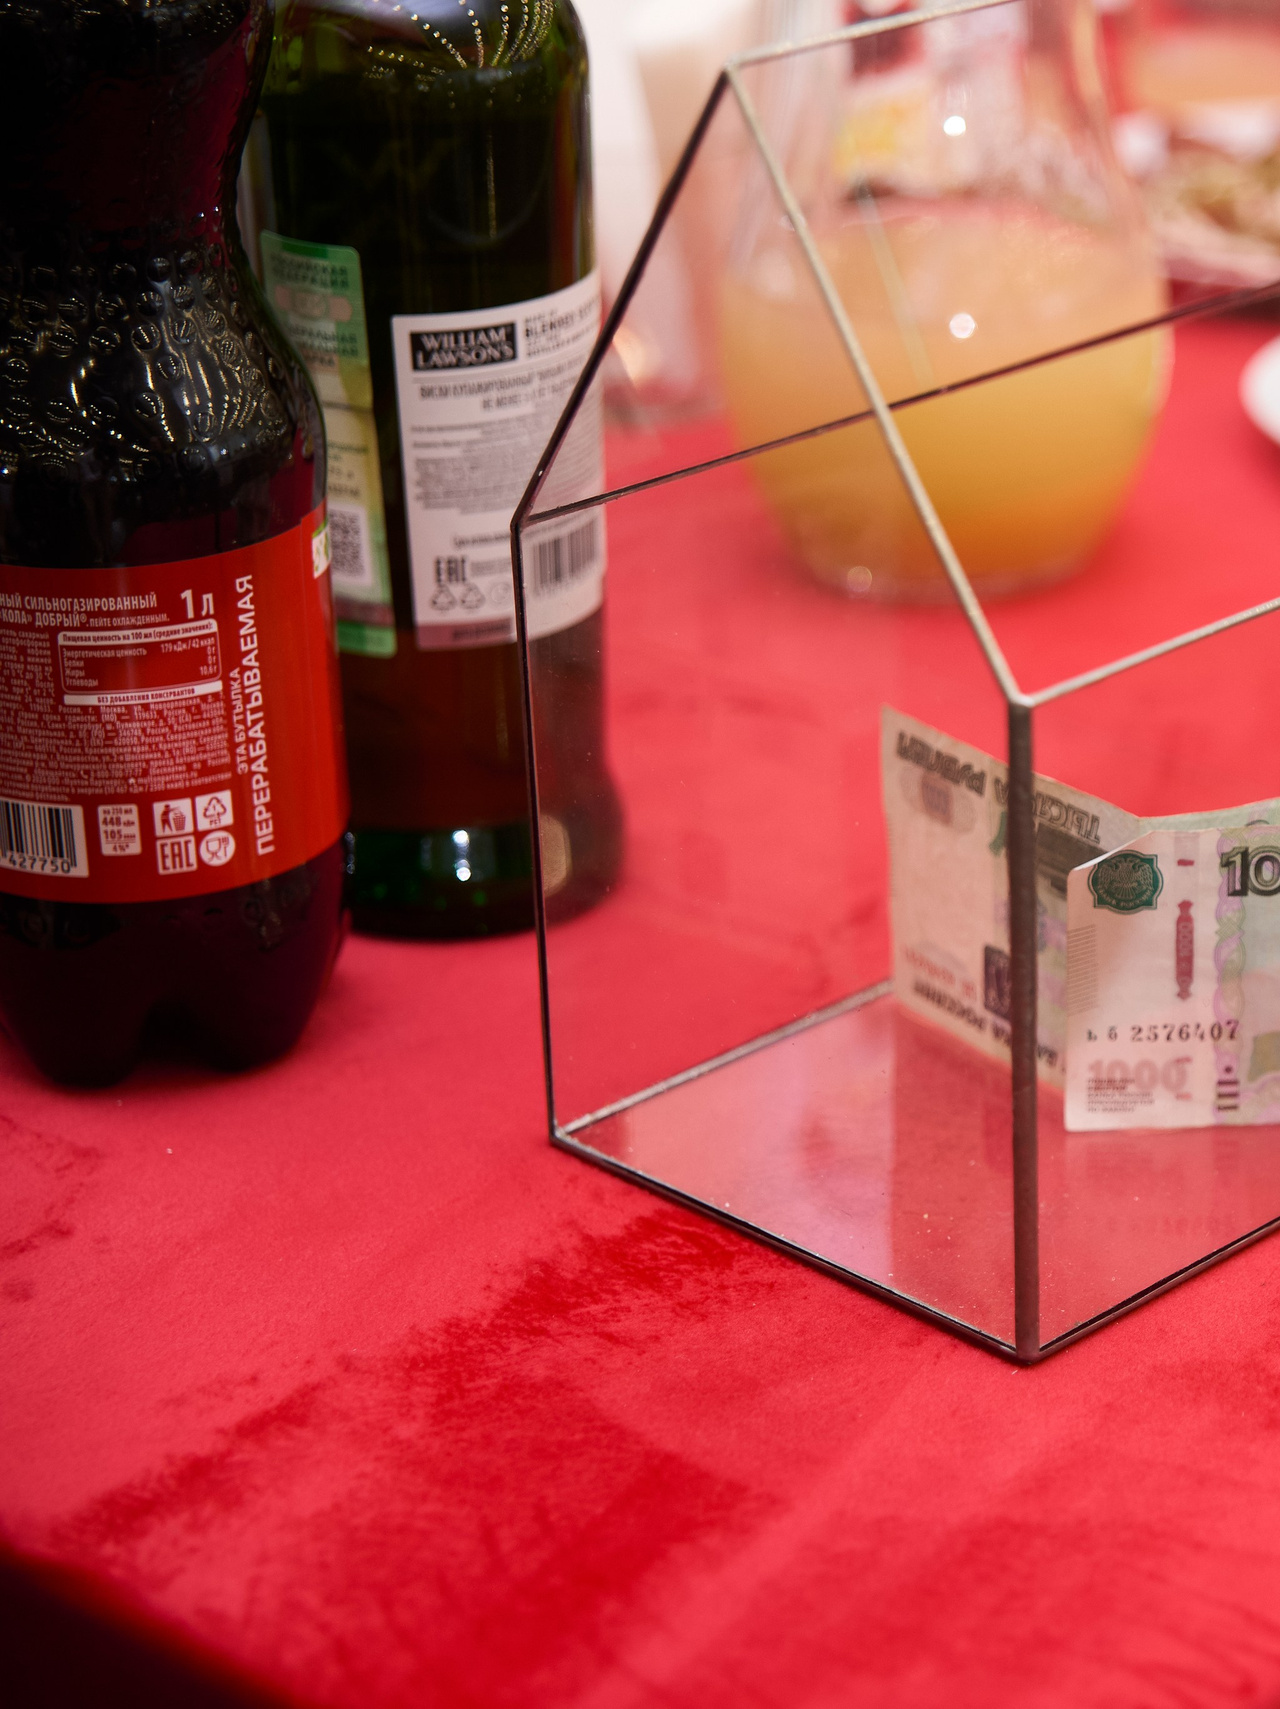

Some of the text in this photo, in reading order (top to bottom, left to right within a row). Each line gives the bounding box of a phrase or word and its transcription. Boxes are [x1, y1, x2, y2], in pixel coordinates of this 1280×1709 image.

[419, 327, 506, 351] WILLIAM
[24, 591, 157, 611] СИЛЬНОГАЗИРОВАННЫЙ
[180, 589, 194, 619] 1
[90, 615, 111, 627] ПЕЙТЕ
[92, 633, 121, 642] ценность
[131, 632, 142, 640] 100
[116, 647, 147, 658] ценность
[110, 693, 149, 704] ДОБАВЛЕНИЯ
[151, 688, 195, 700] КОНСЕРВАНТОВ
[229, 667, 249, 775] ЭТА БУТЫЛКА
[235, 575, 276, 856] ПЕРЕРАБАТЫВАЕМАЯ
[102, 817, 122, 827] 448
[995, 778, 1101, 845] ТЫСЯА
[103, 829, 123, 840] 105
[9, 852, 71, 874] 427750
[159, 839, 194, 870] EAC
[1131, 1018, 1239, 1042] 2576407
